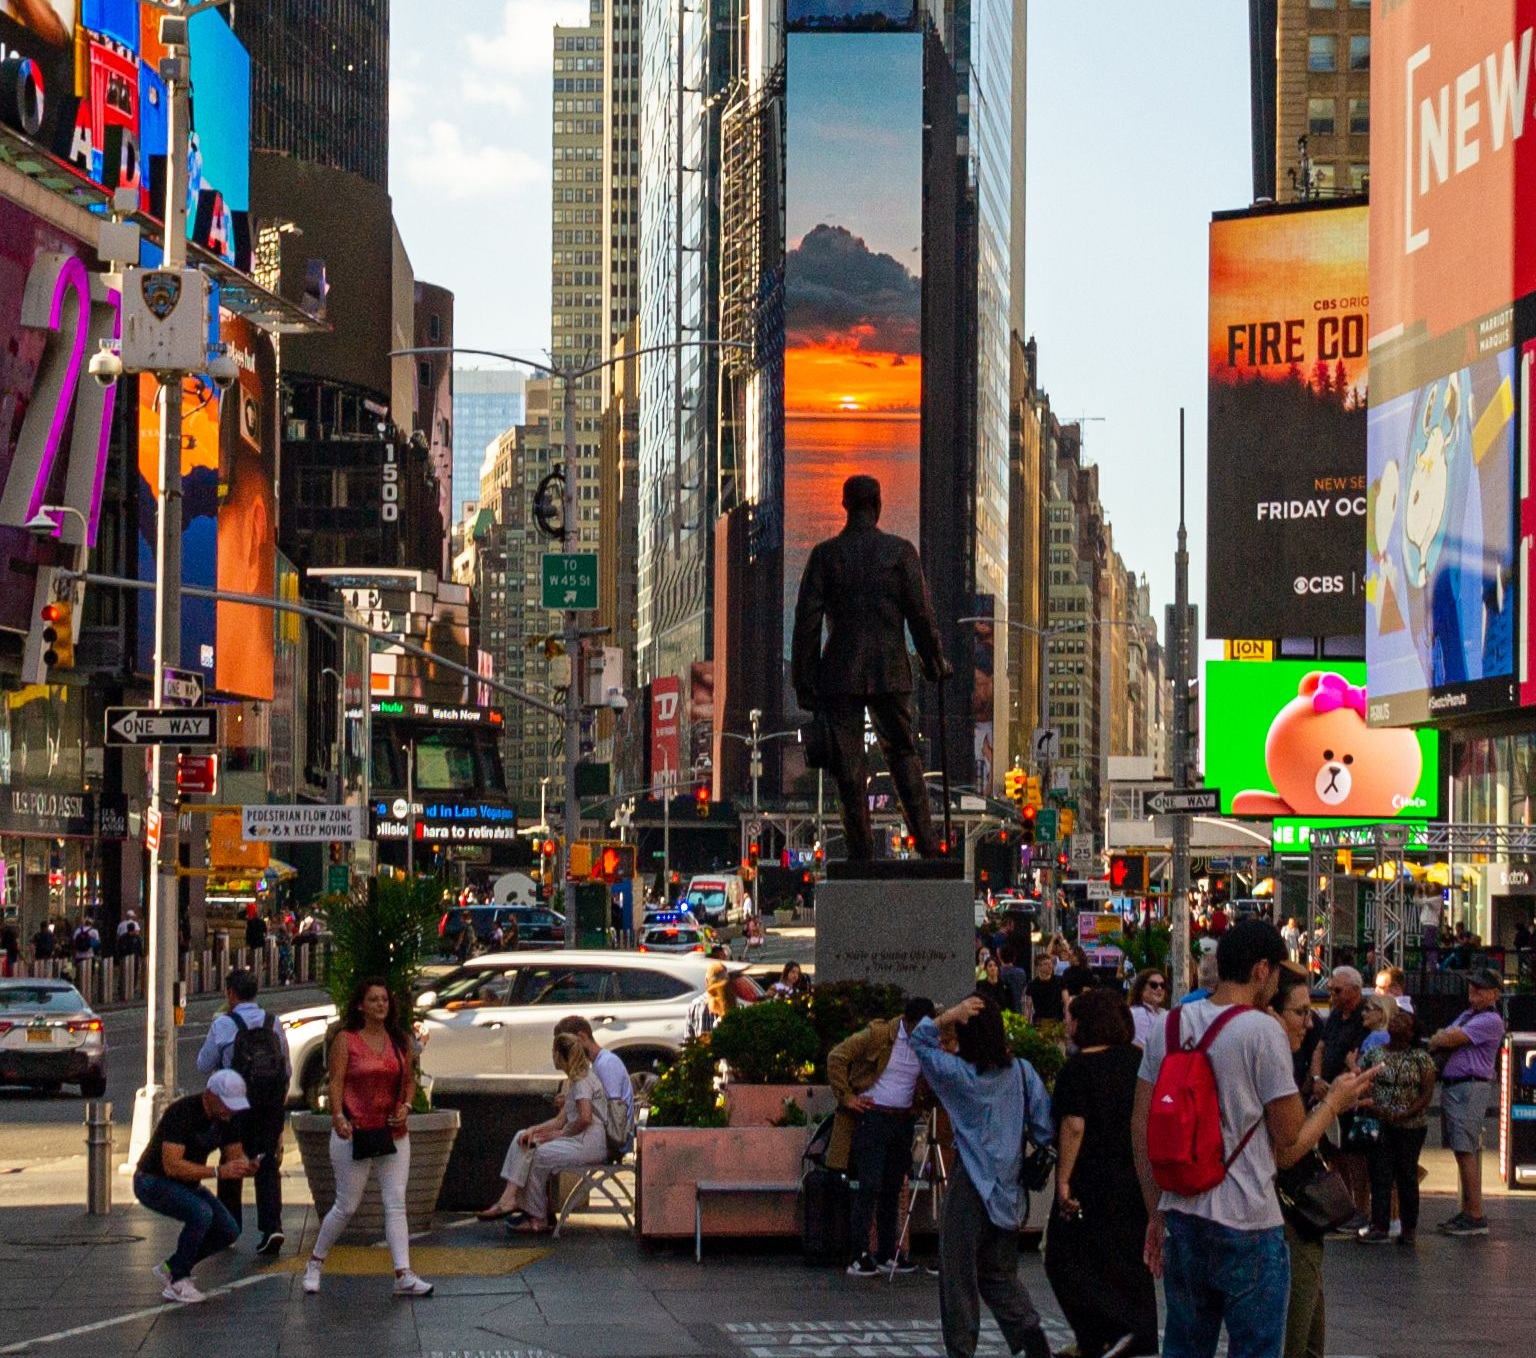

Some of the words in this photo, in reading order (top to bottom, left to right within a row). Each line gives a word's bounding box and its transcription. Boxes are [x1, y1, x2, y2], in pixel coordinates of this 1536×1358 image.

[1313, 301, 1337, 311] CBS
[1340, 299, 1369, 310] ORIG
[1479, 309, 1513, 335] MARRIOTT
[1227, 321, 1305, 368] FIRE
[1317, 314, 1369, 361] CO
[1479, 328, 1510, 352] MARQUIS
[382, 443, 398, 521] 1500
[1314, 479, 1340, 493] NEW
[1345, 477, 1366, 492] SE
[1257, 499, 1328, 521] FRIDAY
[1335, 498, 1366, 516] OC
[563, 559, 577, 571] TO
[549, 575, 558, 585] W
[562, 575, 576, 585] 45
[580, 575, 590, 586] St
[1309, 577, 1344, 594] CBS
[167, 679, 181, 695] ONE
[382, 702, 403, 713] hulu
[459, 710, 480, 721] Now
[124, 720, 153, 733] ONE
[169, 720, 202, 733] WAY
[32, 794, 57, 817] POLO
[58, 797, 85, 818] ASSN.
[1154, 797, 1176, 808] ONE
[1188, 797, 1211, 808] WAY
[247, 810, 300, 822] PEDESTRIAN
[304, 810, 325, 822] FLOW
[329, 810, 352, 822] ZONE
[455, 805, 477, 818] Las
[295, 824, 314, 836] KEEP
[319, 824, 352, 836] MOVING
[452, 825, 465, 838] to
[1074, 849, 1091, 858] 25
